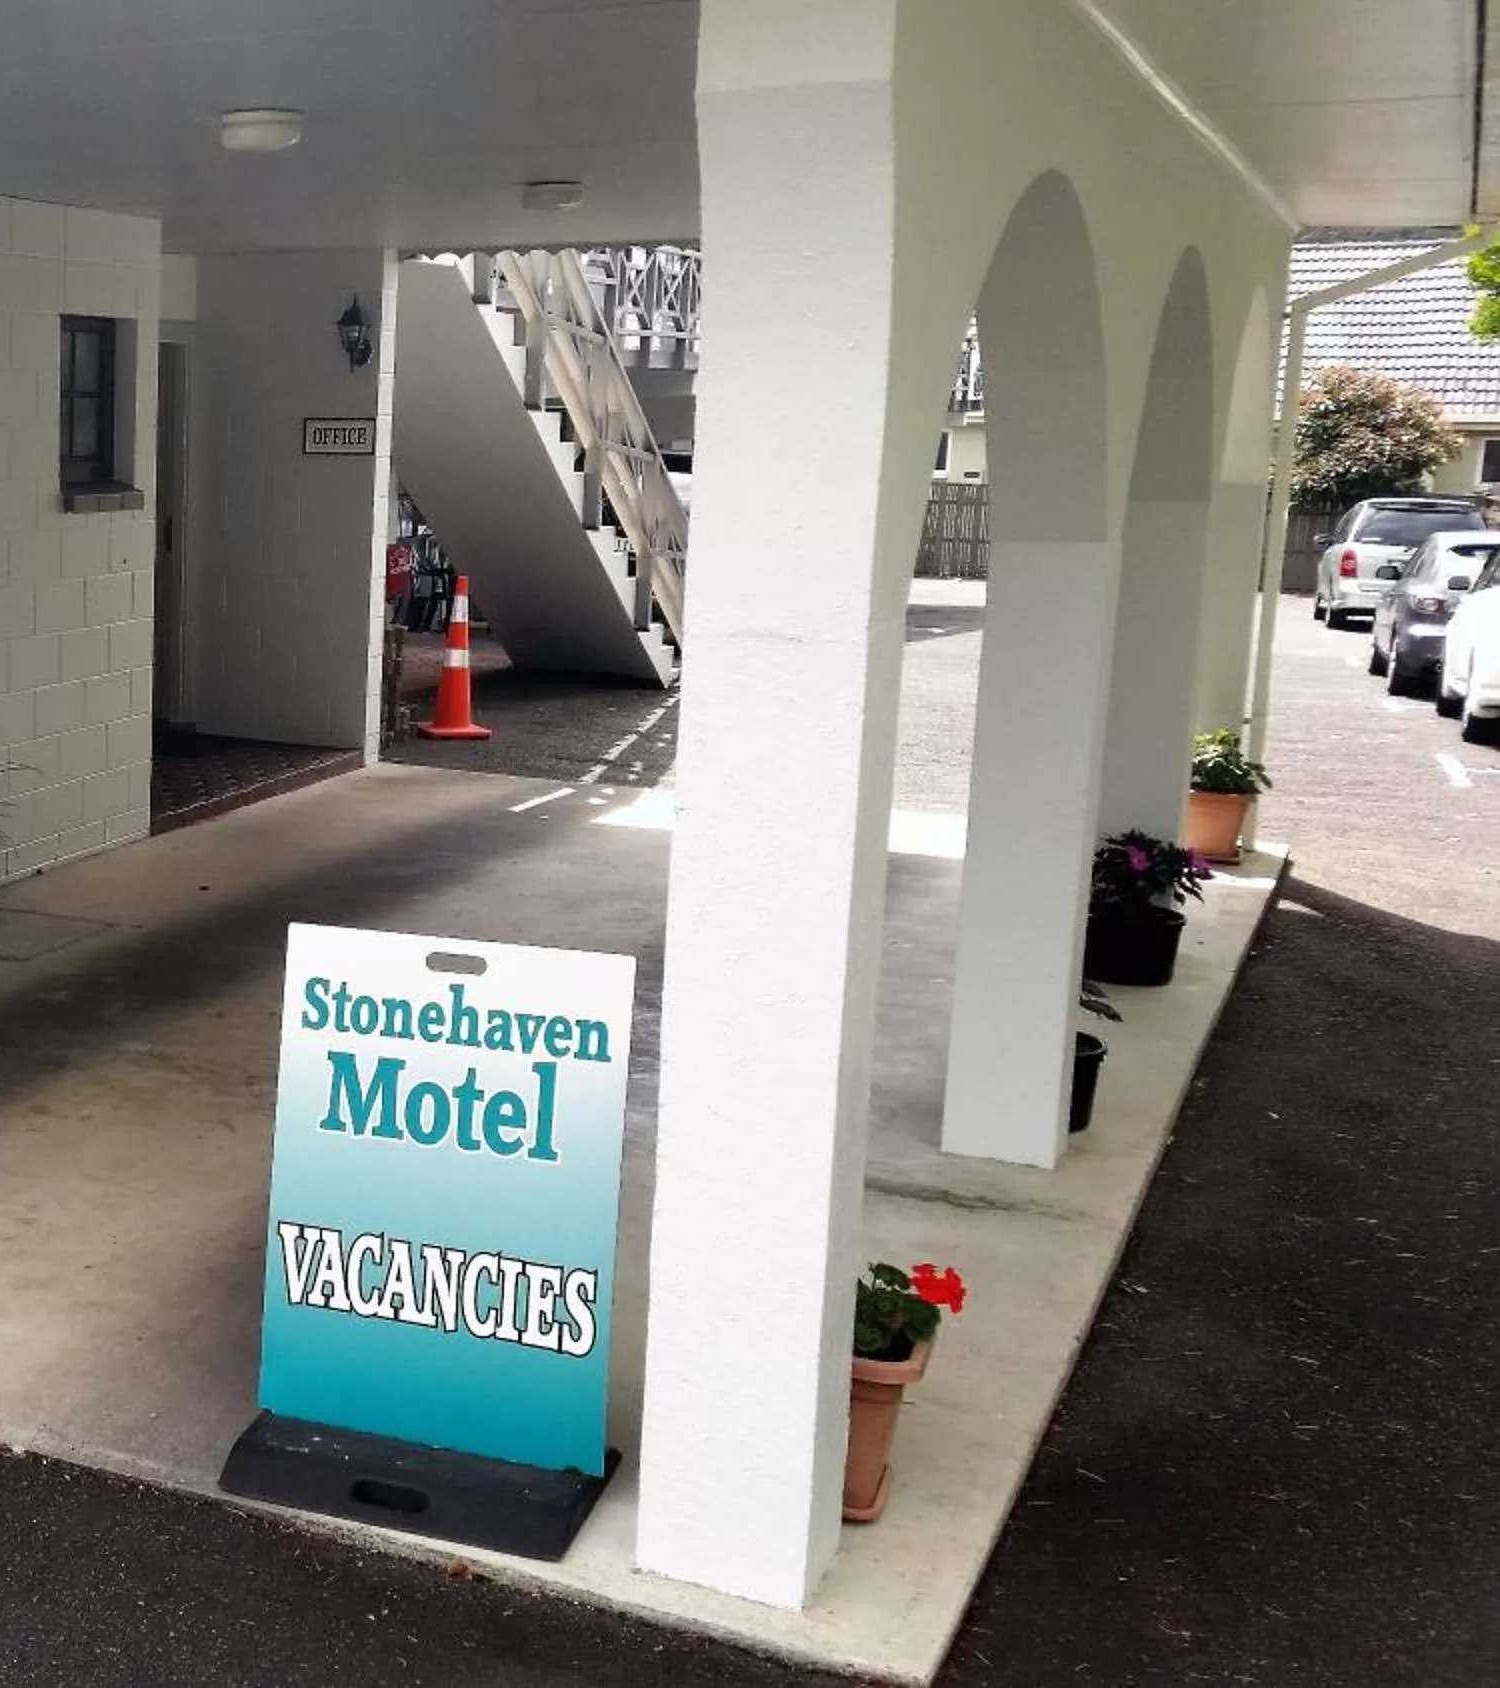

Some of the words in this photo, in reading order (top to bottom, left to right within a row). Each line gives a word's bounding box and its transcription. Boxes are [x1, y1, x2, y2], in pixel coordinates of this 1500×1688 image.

[313, 427, 367, 445] OFFICE
[301, 976, 612, 1063] Stonehaven
[318, 1050, 560, 1162] Motel
[277, 1220, 599, 1357] VACANCIES
